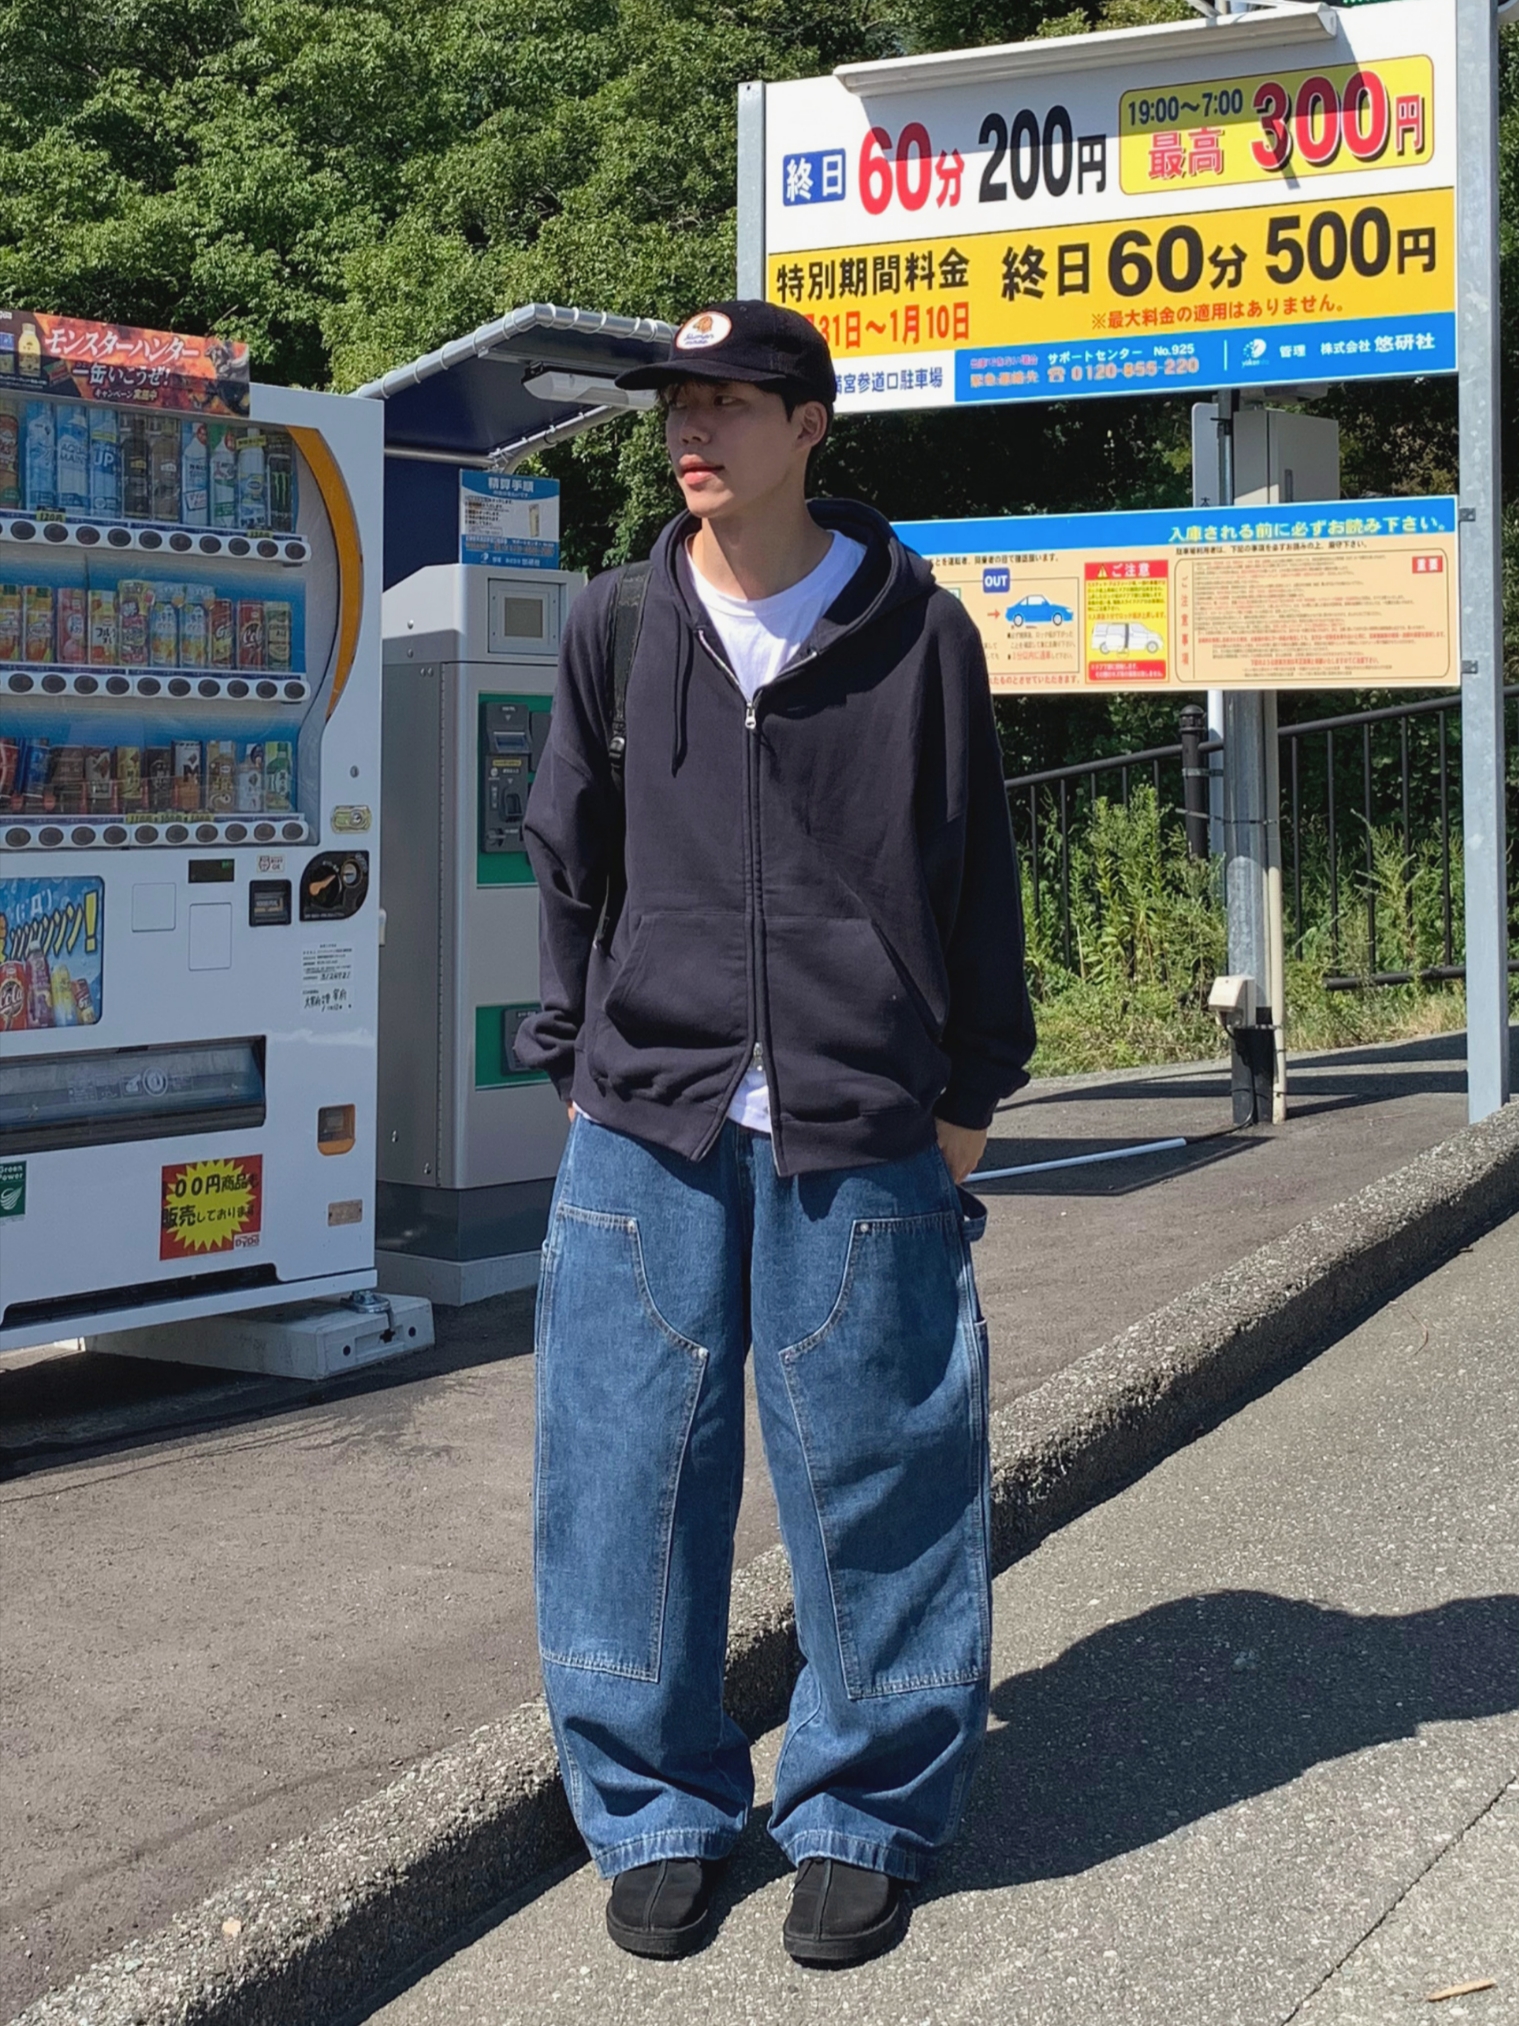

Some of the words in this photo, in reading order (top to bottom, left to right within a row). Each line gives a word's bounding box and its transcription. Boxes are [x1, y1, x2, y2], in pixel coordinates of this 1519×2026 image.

[786, 153, 843, 203] 終日
[859, 121, 965, 215] 60分
[978, 104, 1107, 203] 200円
[1148, 127, 1226, 180] 最高
[1250, 69, 1426, 171] 300円
[776, 247, 971, 304] 特別期間料金
[1001, 243, 1091, 302] 終日
[1107, 224, 1248, 298] 60分
[1265, 206, 1437, 286] 500円
[45, 328, 199, 366] モンスターハンター
[1047, 350, 1143, 365] サポートセンター
[1153, 343, 1195, 356] No.925
[1279, 344, 1306, 358] 管理
[1320, 339, 1371, 355] 株式会社
[1168, 515, 1446, 544] 入庫される前に必ずお読み下さい。
[1111, 562, 1150, 578] ご注意
[1416, 557, 1441, 572] 重要
[984, 575, 1008, 588] OUT
